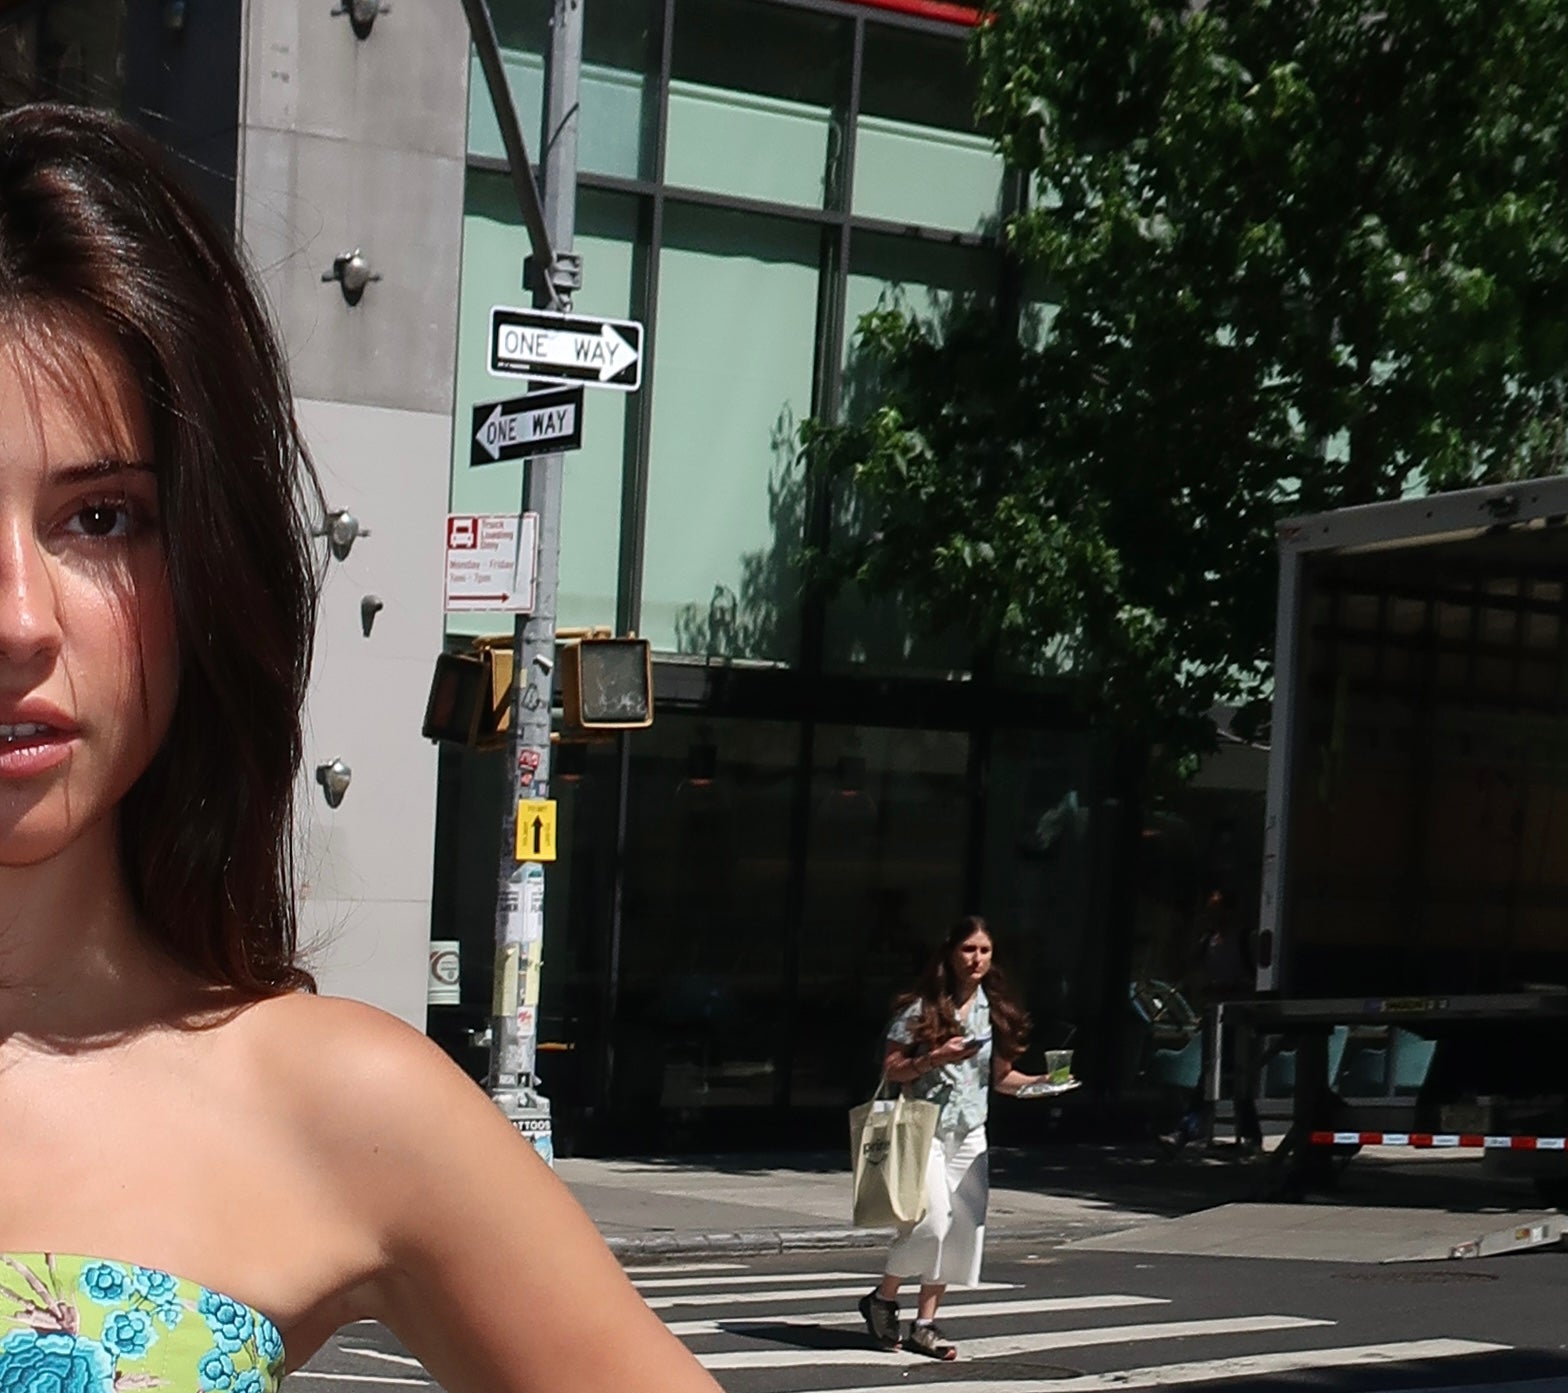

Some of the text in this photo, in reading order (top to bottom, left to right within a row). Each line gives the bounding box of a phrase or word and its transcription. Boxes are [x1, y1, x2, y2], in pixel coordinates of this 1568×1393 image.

[505, 330, 620, 366] ONE WAY
[486, 408, 568, 445] ONE WAY
